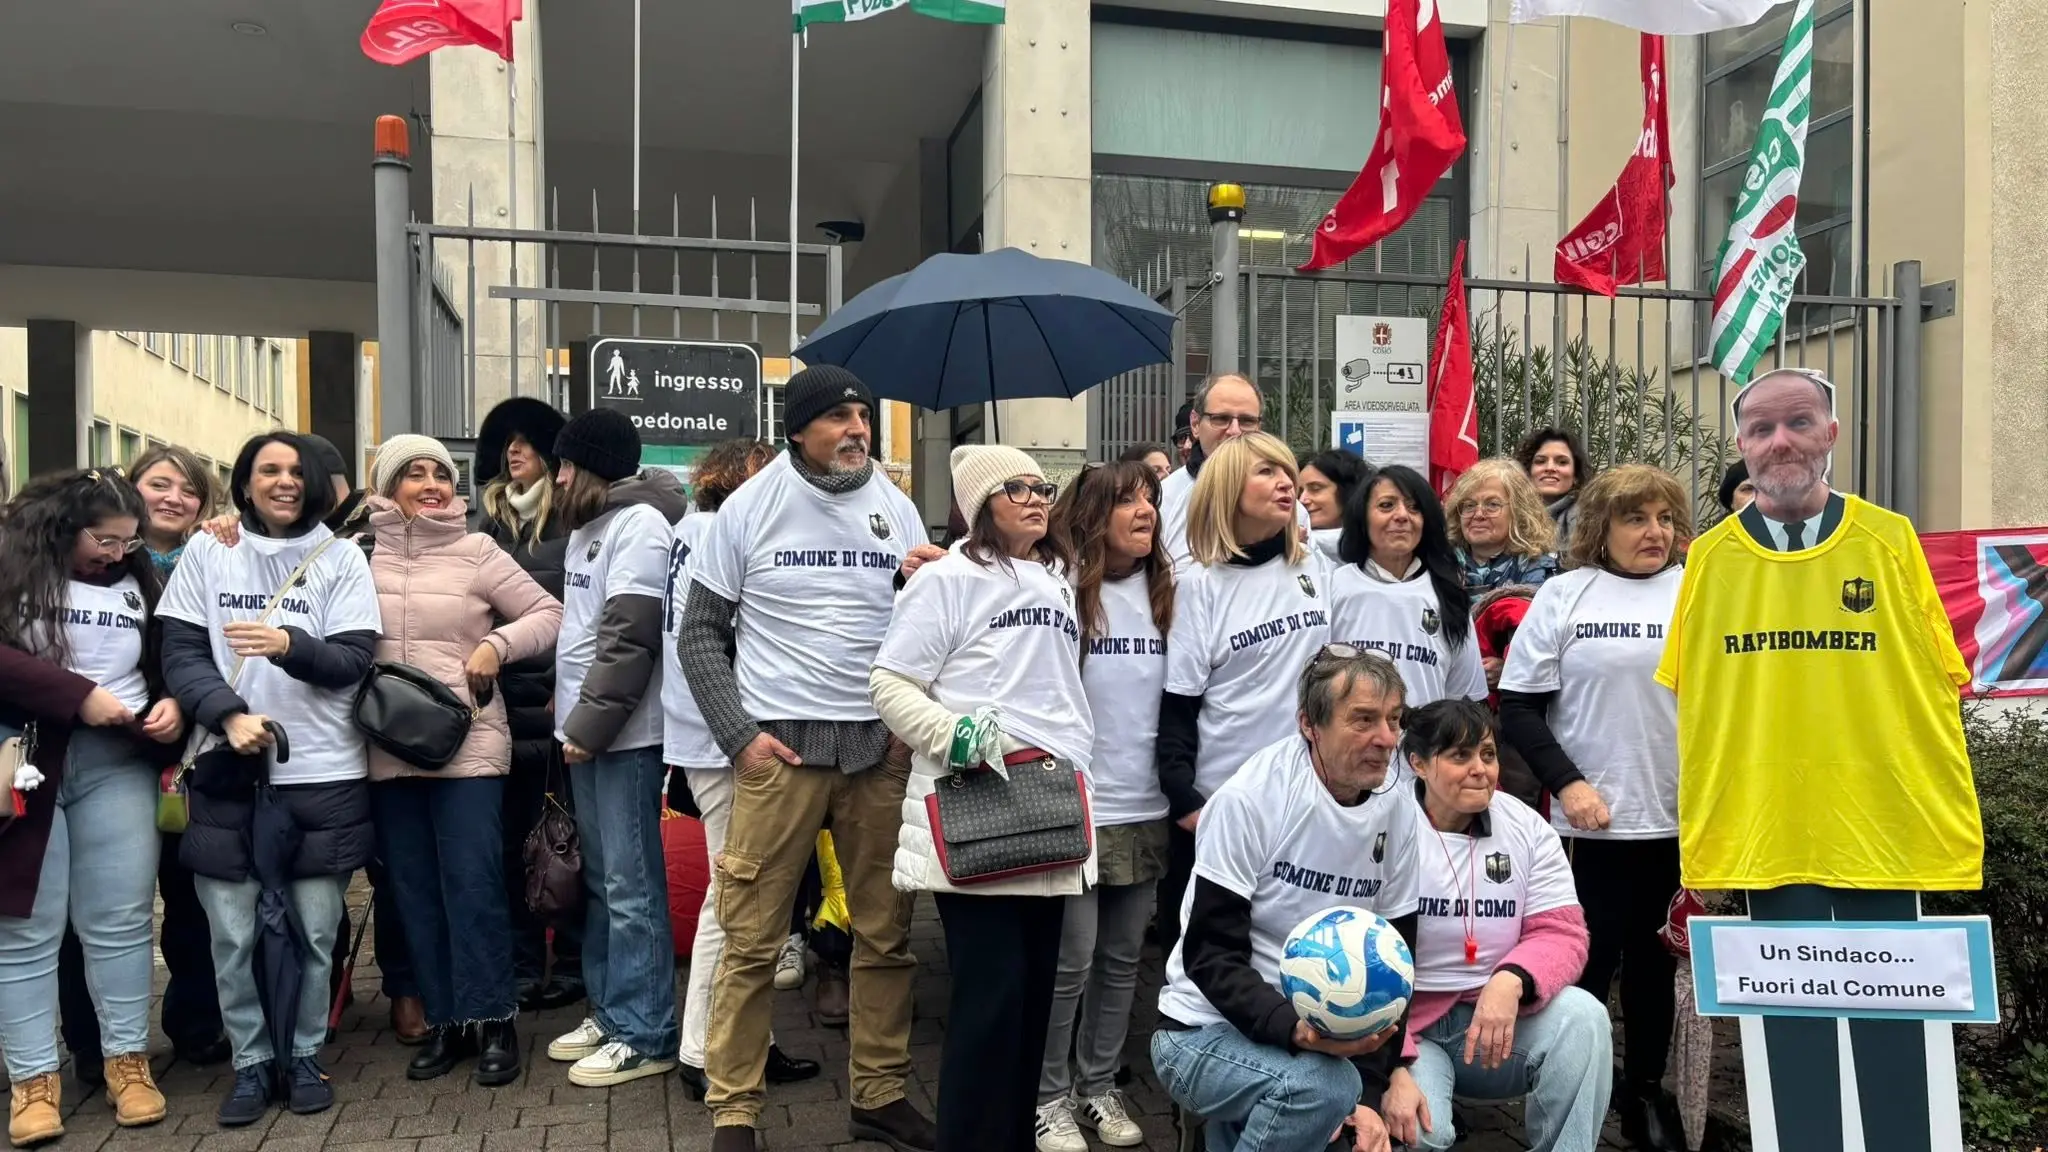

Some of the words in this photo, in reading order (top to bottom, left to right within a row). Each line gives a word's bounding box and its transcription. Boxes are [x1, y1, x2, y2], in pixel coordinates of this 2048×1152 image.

[655, 370, 743, 391] ingresso
[1344, 400, 1361, 410] AREA
[1363, 401, 1420, 411] VIDEOSORVEGLIATA
[631, 413, 728, 430] pedonale
[774, 551, 837, 567] COMUNE
[842, 551, 857, 567] DI
[862, 551, 897, 570] COMO
[219, 592, 267, 609] COMUNE
[281, 597, 310, 614] OMO
[97, 611, 113, 626] DI
[116, 614, 138, 629] COM
[989, 607, 1051, 629] COMUNE
[1229, 618, 1286, 652] COMUNE
[1286, 614, 1302, 632] DI
[1302, 610, 1328, 628] COM
[1576, 622, 1641, 639] COMUNE
[1647, 622, 1663, 639] DI
[1090, 637, 1130, 655] MUNE
[1133, 637, 1146, 655] DI
[1724, 630, 1877, 654] RAPIBOMBER
[1388, 642, 1402, 659] DI
[1405, 644, 1438, 667] COMO
[1272, 861, 1336, 893] COMUNE
[1335, 876, 1353, 897] DI
[1352, 878, 1382, 898] COMO
[1417, 897, 1450, 917] UNE
[1454, 899, 1469, 917] DI
[1474, 900, 1516, 918] COMO
[1760, 944, 1791, 961] Un
[1797, 945, 1915, 963] Sindaco...
[1738, 976, 1795, 994] Fuori
[1801, 979, 1838, 996] dal
[1843, 980, 1946, 997] Comune
